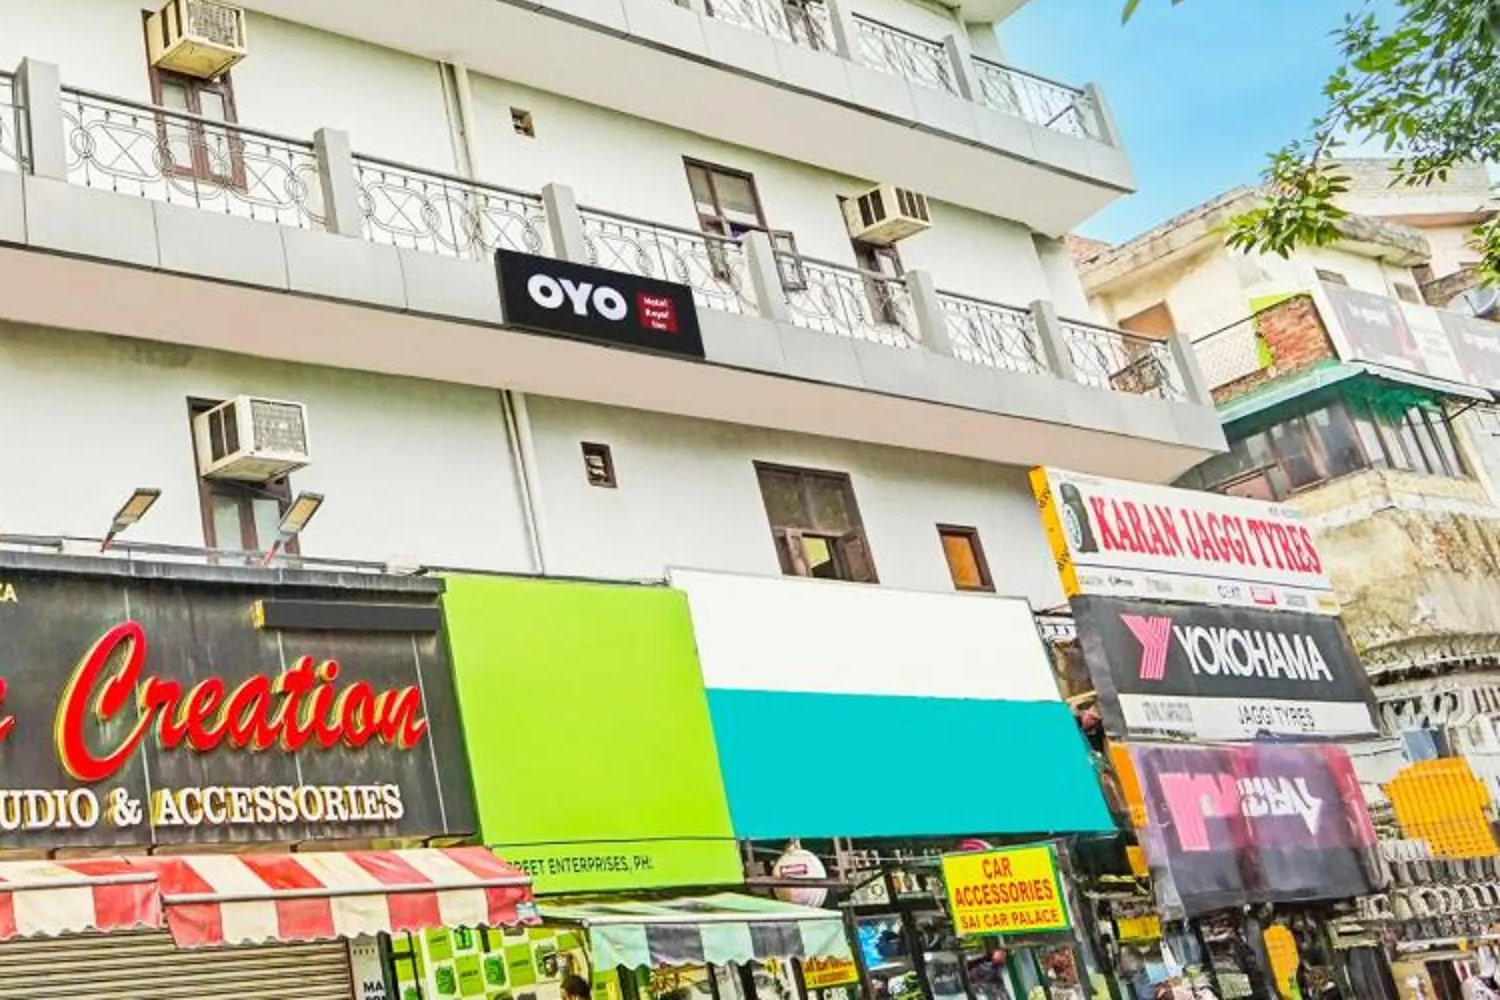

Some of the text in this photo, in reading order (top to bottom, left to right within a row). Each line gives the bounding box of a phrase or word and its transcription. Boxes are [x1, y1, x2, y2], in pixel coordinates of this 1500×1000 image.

[527, 273, 628, 321] OYO
[1089, 495, 1184, 558] KARAN
[1180, 507, 1250, 565] JAGGI
[1248, 519, 1323, 574] TYRES
[1173, 624, 1334, 682] YOKOHAMA
[54, 620, 430, 782] Creation
[1237, 705, 1316, 728] JAGGI TYRES
[107, 791, 143, 829] &
[150, 781, 404, 827] ACCESSORIES
[955, 878, 1054, 906] ACCESSORIES
[982, 857, 1013, 880] CAR
[960, 909, 1061, 929] SAI CAR PALACE
